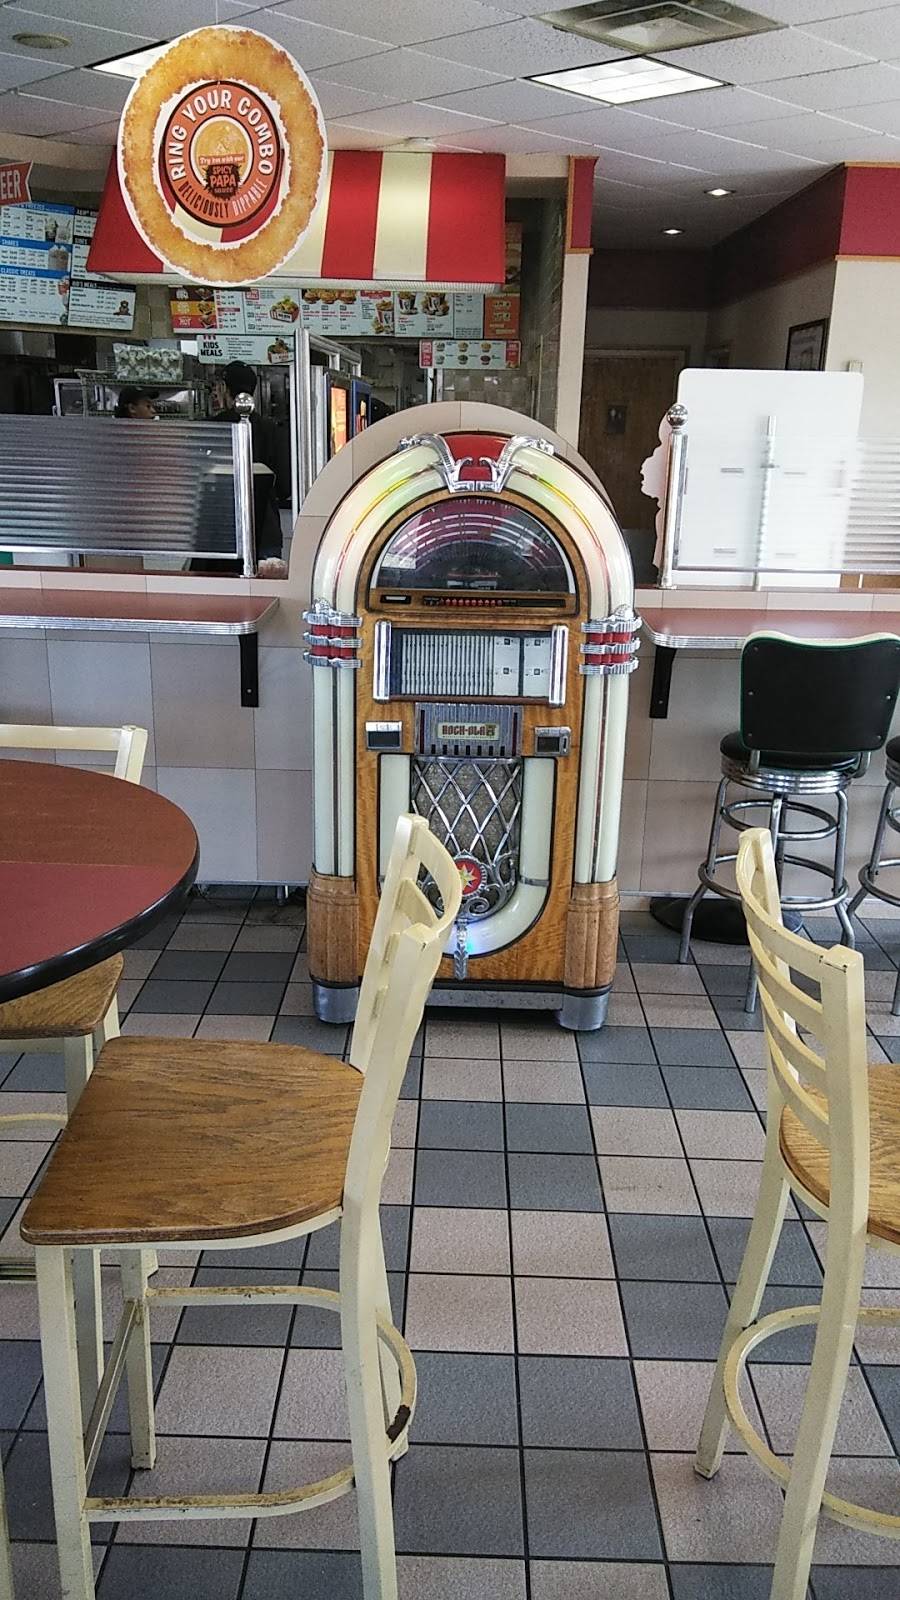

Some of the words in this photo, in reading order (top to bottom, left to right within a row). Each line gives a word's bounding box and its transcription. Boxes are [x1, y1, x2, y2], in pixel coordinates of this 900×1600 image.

[168, 125, 187, 181] RING
[181, 89, 232, 123] YOUR
[237, 96, 274, 175] COMBO
[212, 165, 233, 175] SPICY
[209, 174, 237, 188] PAPA
[178, 181, 229, 218] DELICIOUSLY
[232, 178, 267, 216] DIPPABLE
[203, 341, 219, 349] KIDS
[200, 349, 223, 357] MEALS
